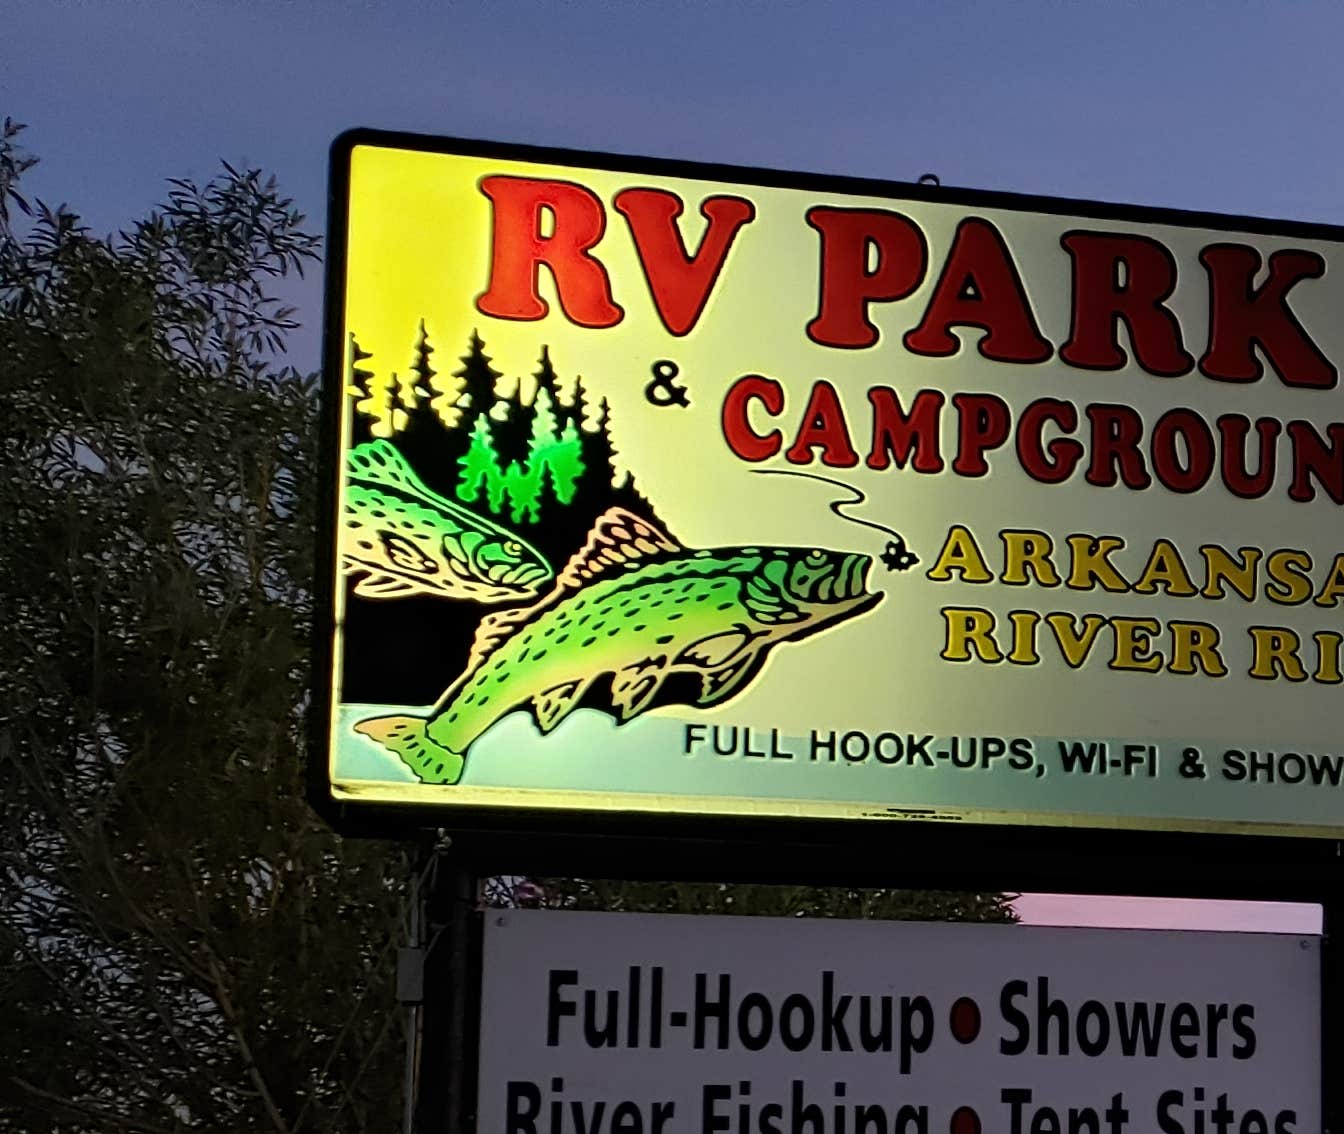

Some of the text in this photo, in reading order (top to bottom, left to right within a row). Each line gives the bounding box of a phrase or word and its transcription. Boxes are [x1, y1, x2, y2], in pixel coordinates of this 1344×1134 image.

[476, 173, 1339, 390] RV PARK
[645, 359, 690, 408] &
[940, 606, 1229, 678] RIVER
[684, 725, 792, 762] FULL
[809, 729, 1046, 781] HOOK-UPS,
[1059, 739, 1158, 778] WI-FI
[1177, 746, 1207, 780] &
[546, 965, 1258, 1075] Full-Hookup Showers
